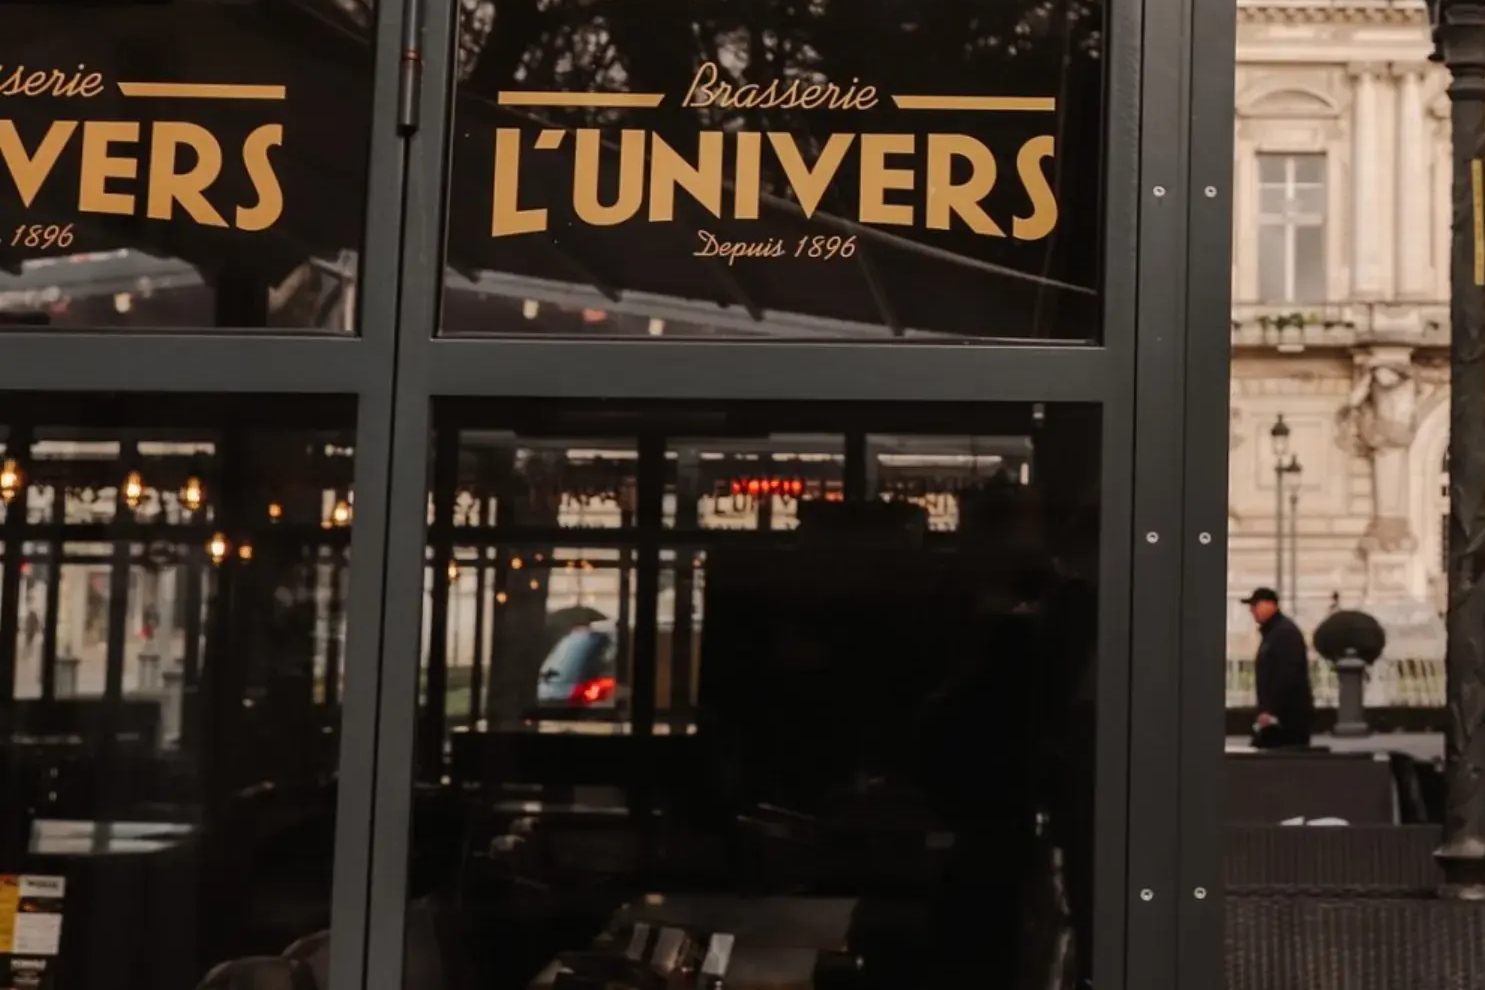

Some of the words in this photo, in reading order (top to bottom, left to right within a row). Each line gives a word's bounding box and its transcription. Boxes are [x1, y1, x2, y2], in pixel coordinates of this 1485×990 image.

[0, 64, 104, 97] serie
[682, 62, 879, 110] Brasserie
[0, 119, 284, 231] VERS
[491, 127, 1059, 241] L'UNIVERS
[11, 223, 74, 250] 1896
[692, 229, 786, 267] Depuis
[794, 235, 857, 260] 1896
